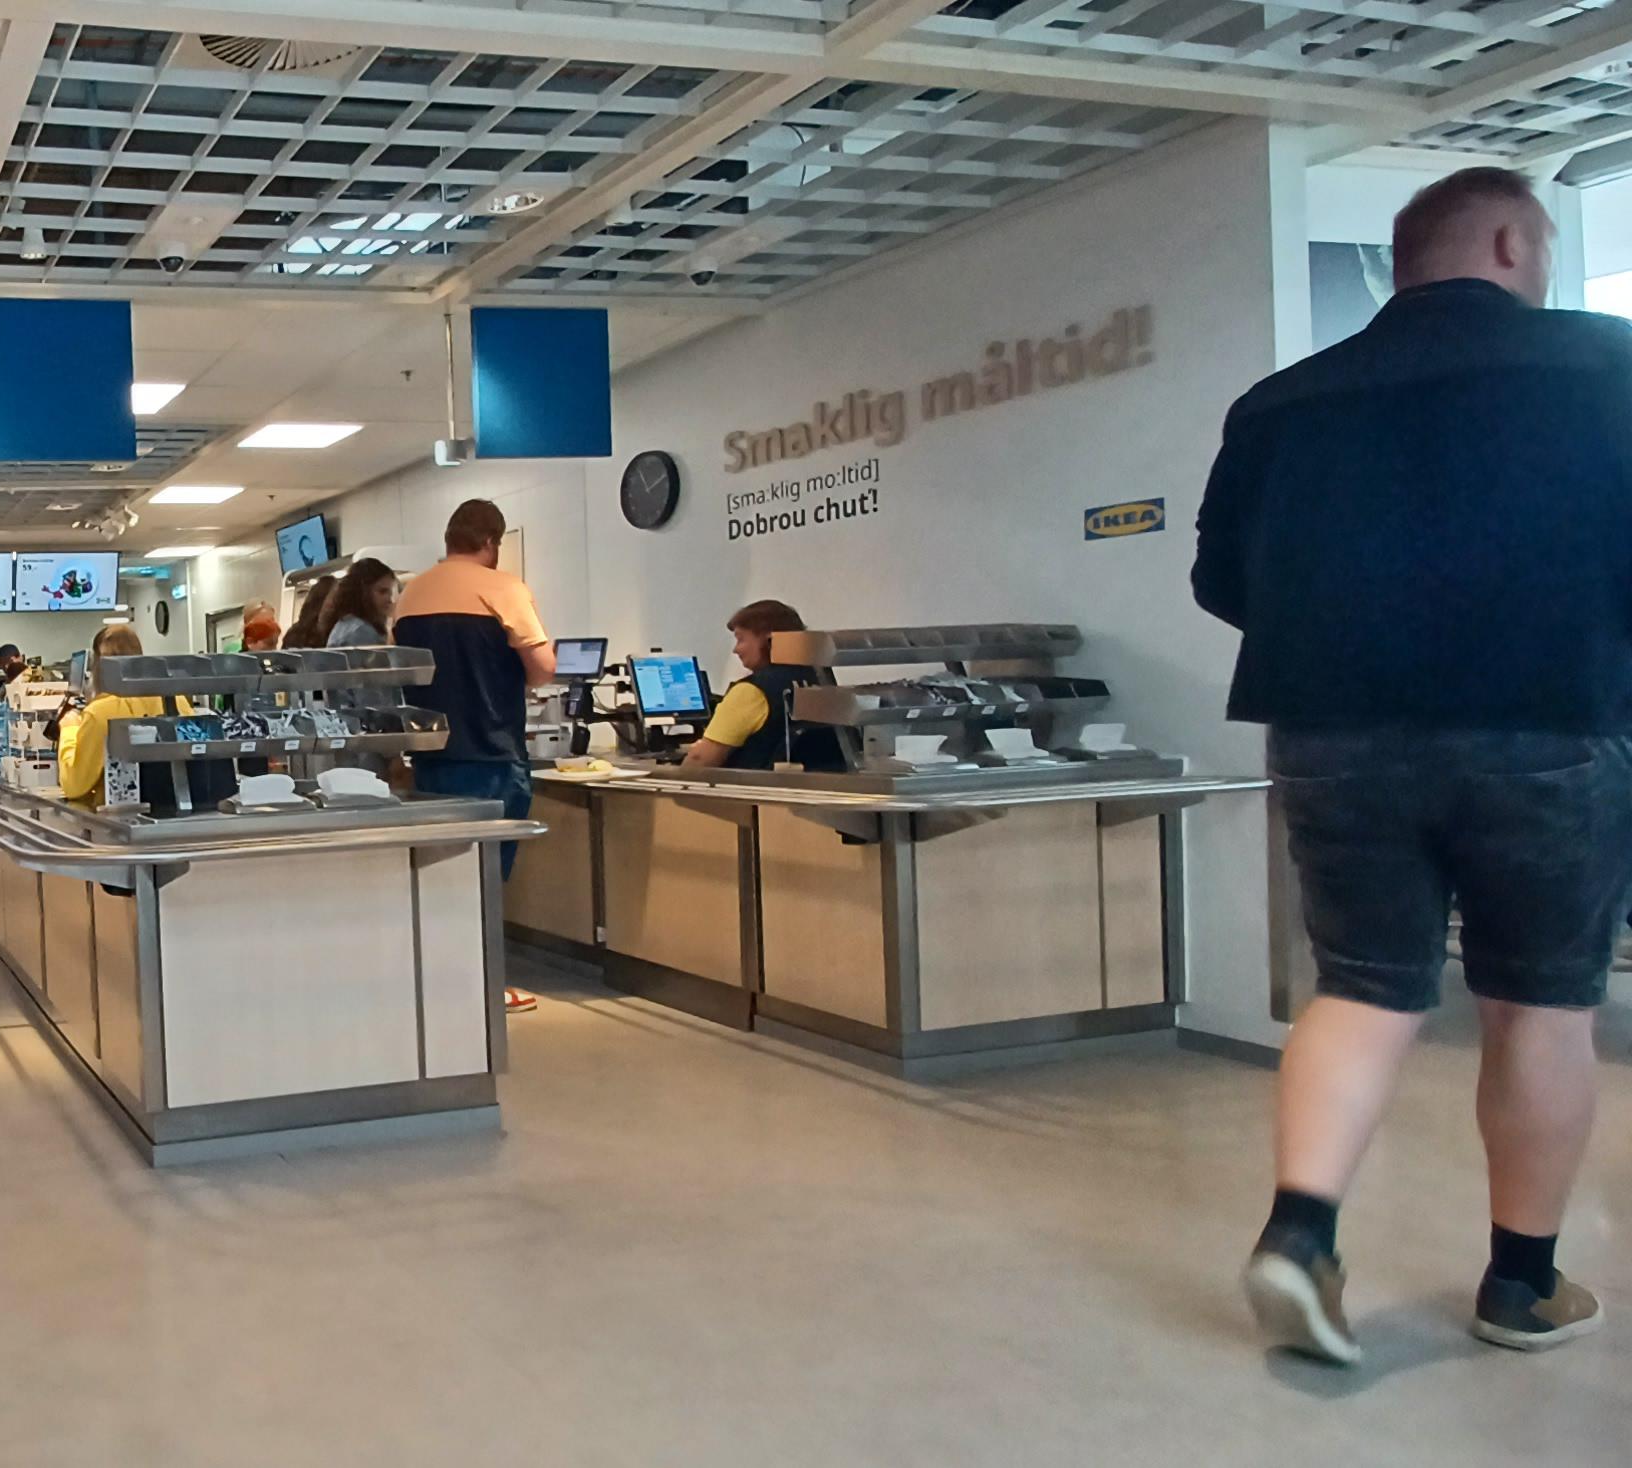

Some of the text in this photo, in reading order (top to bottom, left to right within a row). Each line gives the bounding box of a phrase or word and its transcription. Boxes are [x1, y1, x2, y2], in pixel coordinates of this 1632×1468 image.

[723, 304, 1156, 474] Smaklig måltid!
[727, 458, 881, 514] [sma:klig mo:ltid]
[728, 487, 879, 541] Dobrou chuť!
